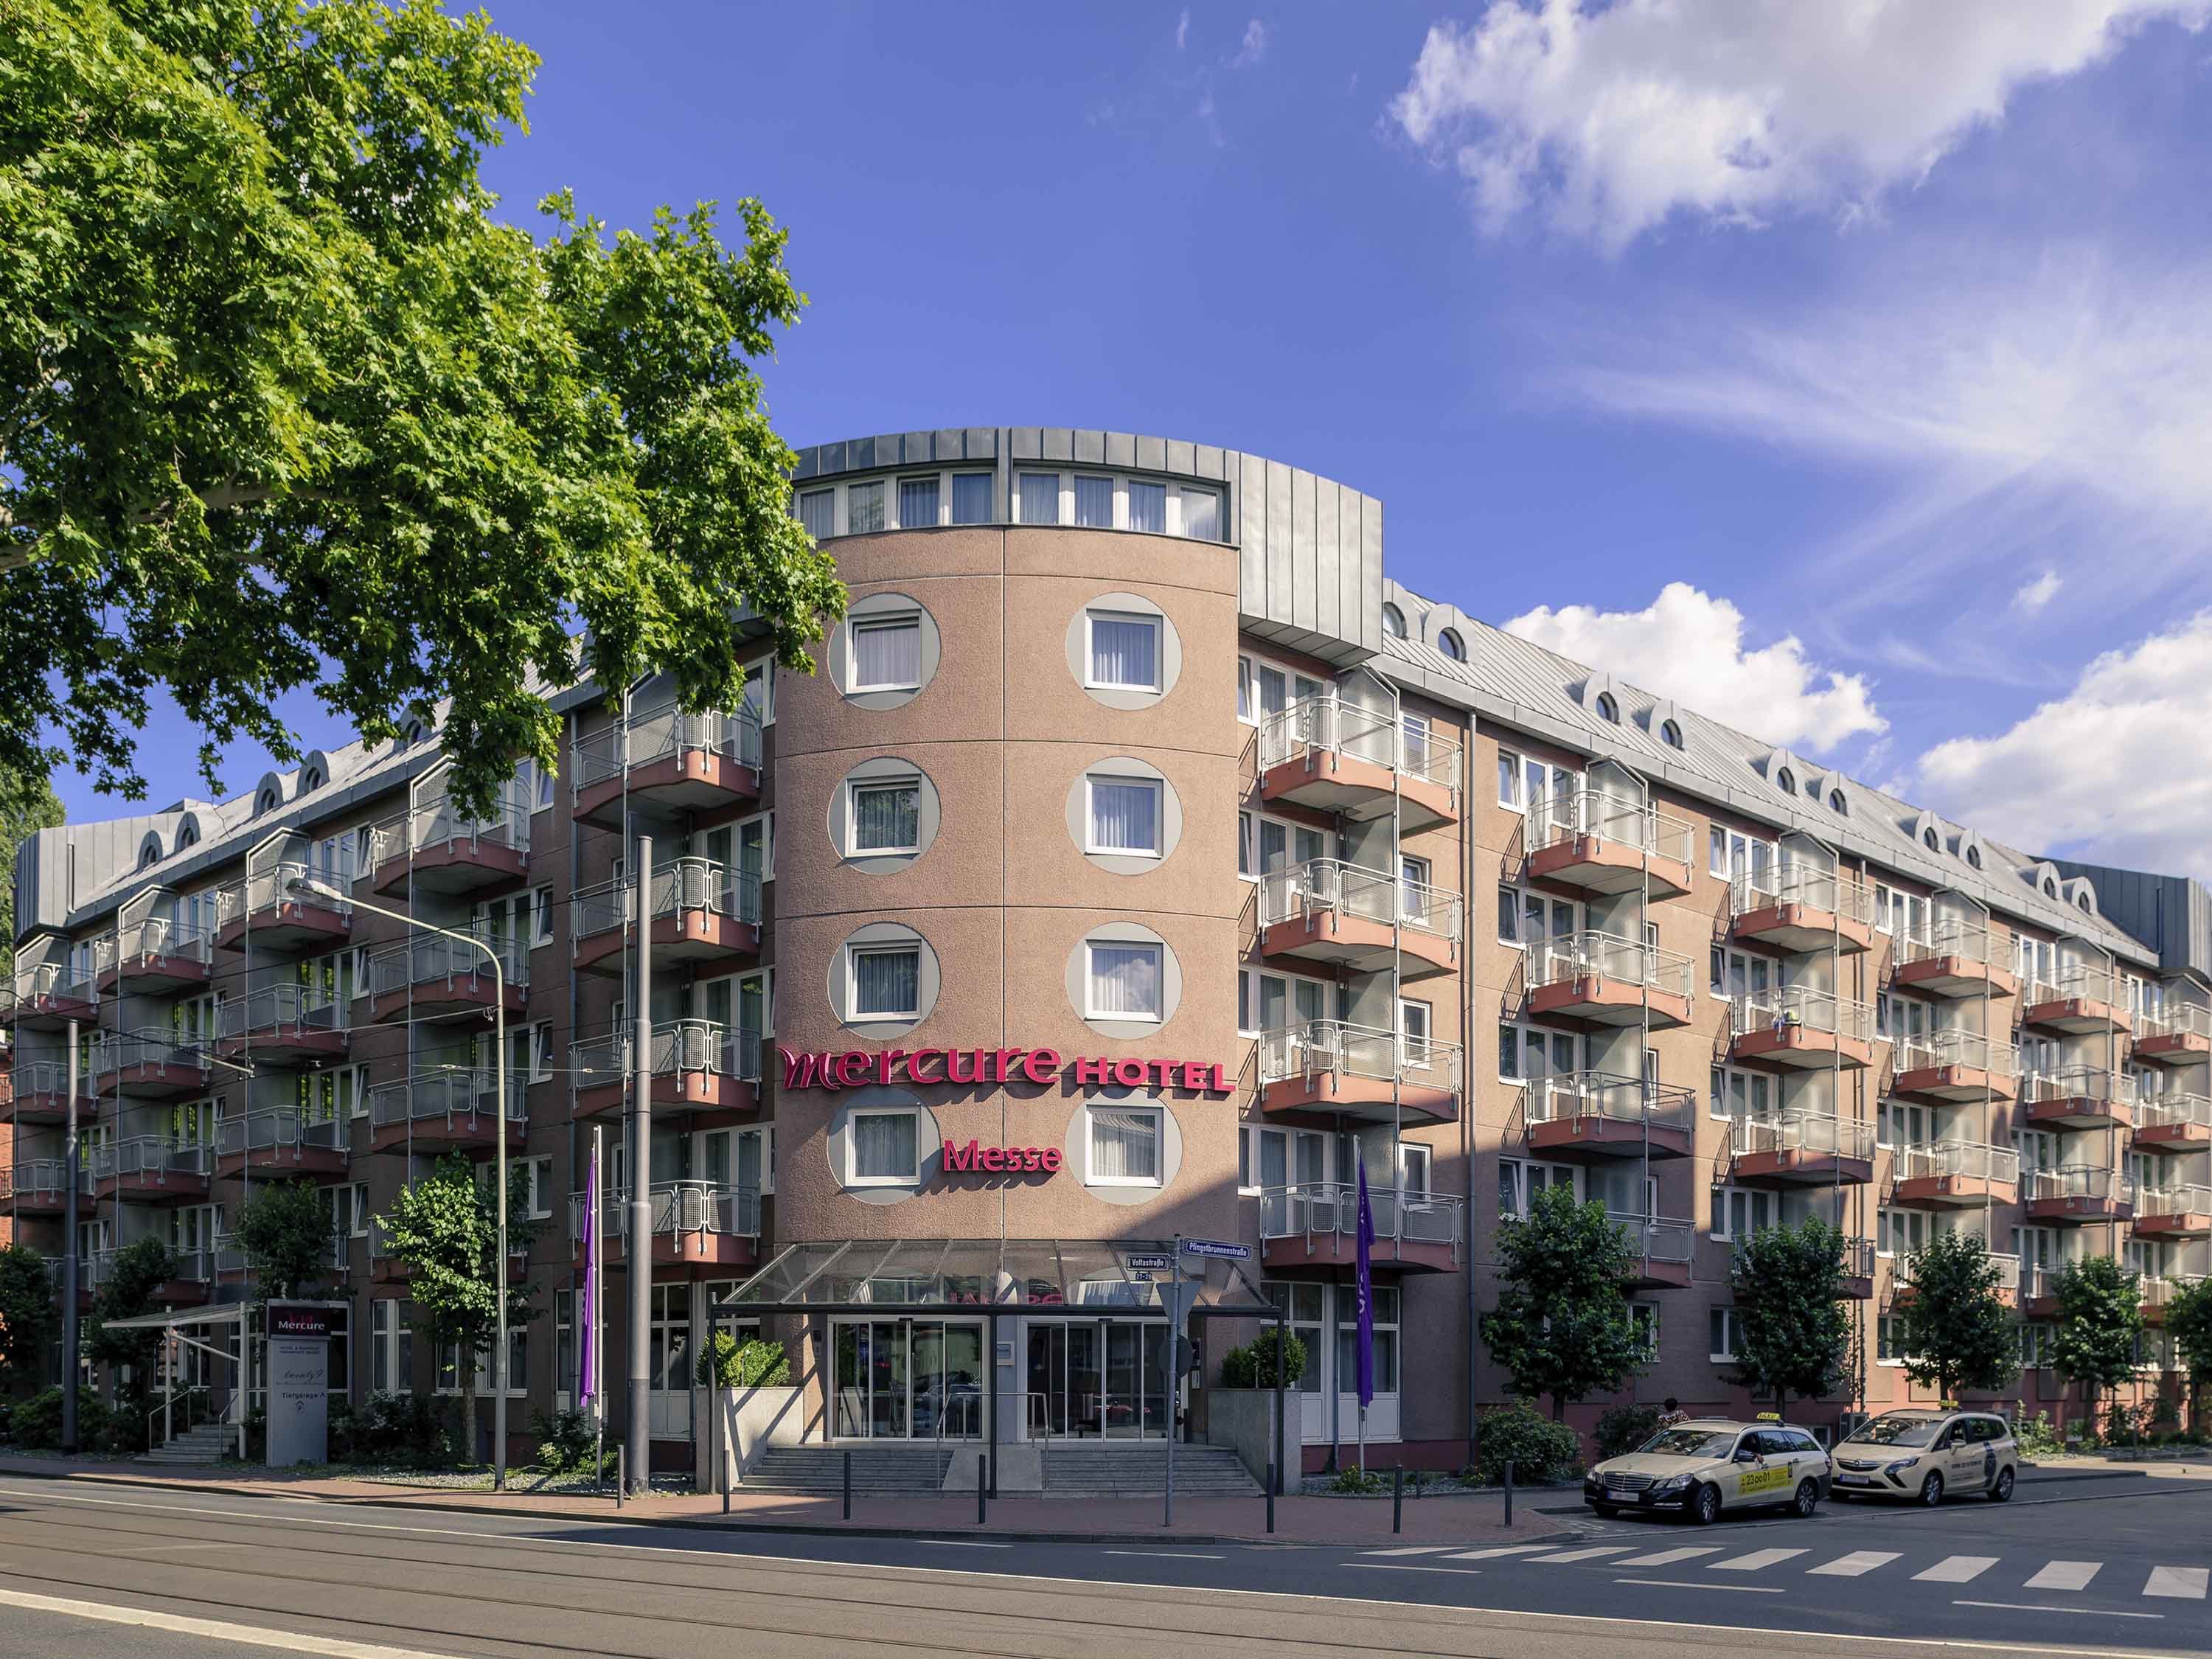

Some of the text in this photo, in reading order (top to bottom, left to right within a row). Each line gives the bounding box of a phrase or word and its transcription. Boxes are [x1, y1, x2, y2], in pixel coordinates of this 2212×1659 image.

[1077, 1056, 1237, 1092] HOTEL
[943, 1139, 1062, 1172] Messe
[1189, 1242, 1247, 1256] Pfingstbrunnenstraße
[1132, 1259, 1164, 1267] Voltastraße
[279, 1321, 324, 1330] Mercure
